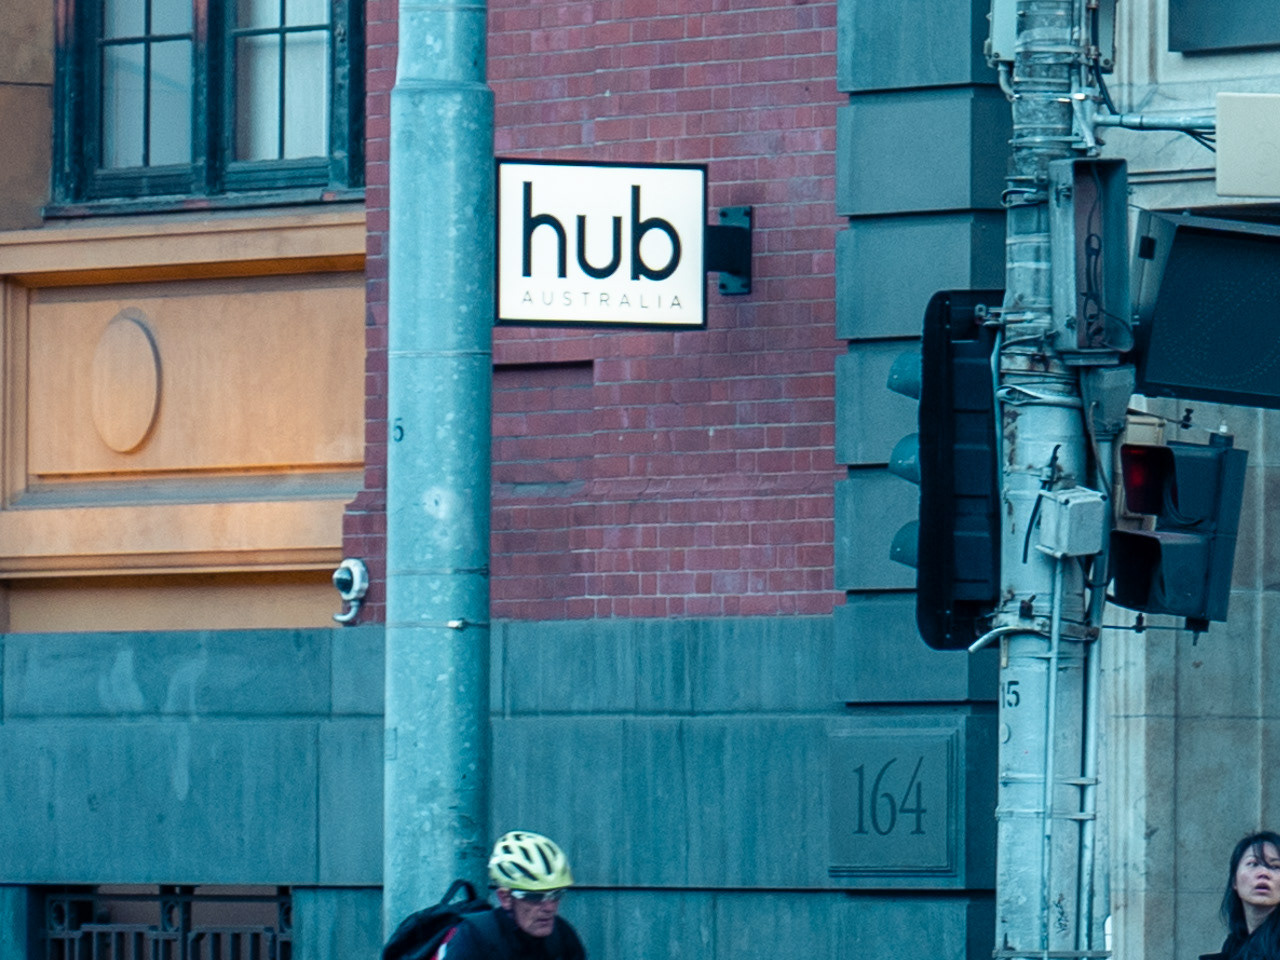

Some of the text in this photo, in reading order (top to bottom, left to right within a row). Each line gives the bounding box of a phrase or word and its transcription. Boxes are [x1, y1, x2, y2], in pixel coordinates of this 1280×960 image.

[522, 180, 683, 281] hub
[521, 290, 683, 309] AUSTRALIA
[852, 756, 927, 836] 164
